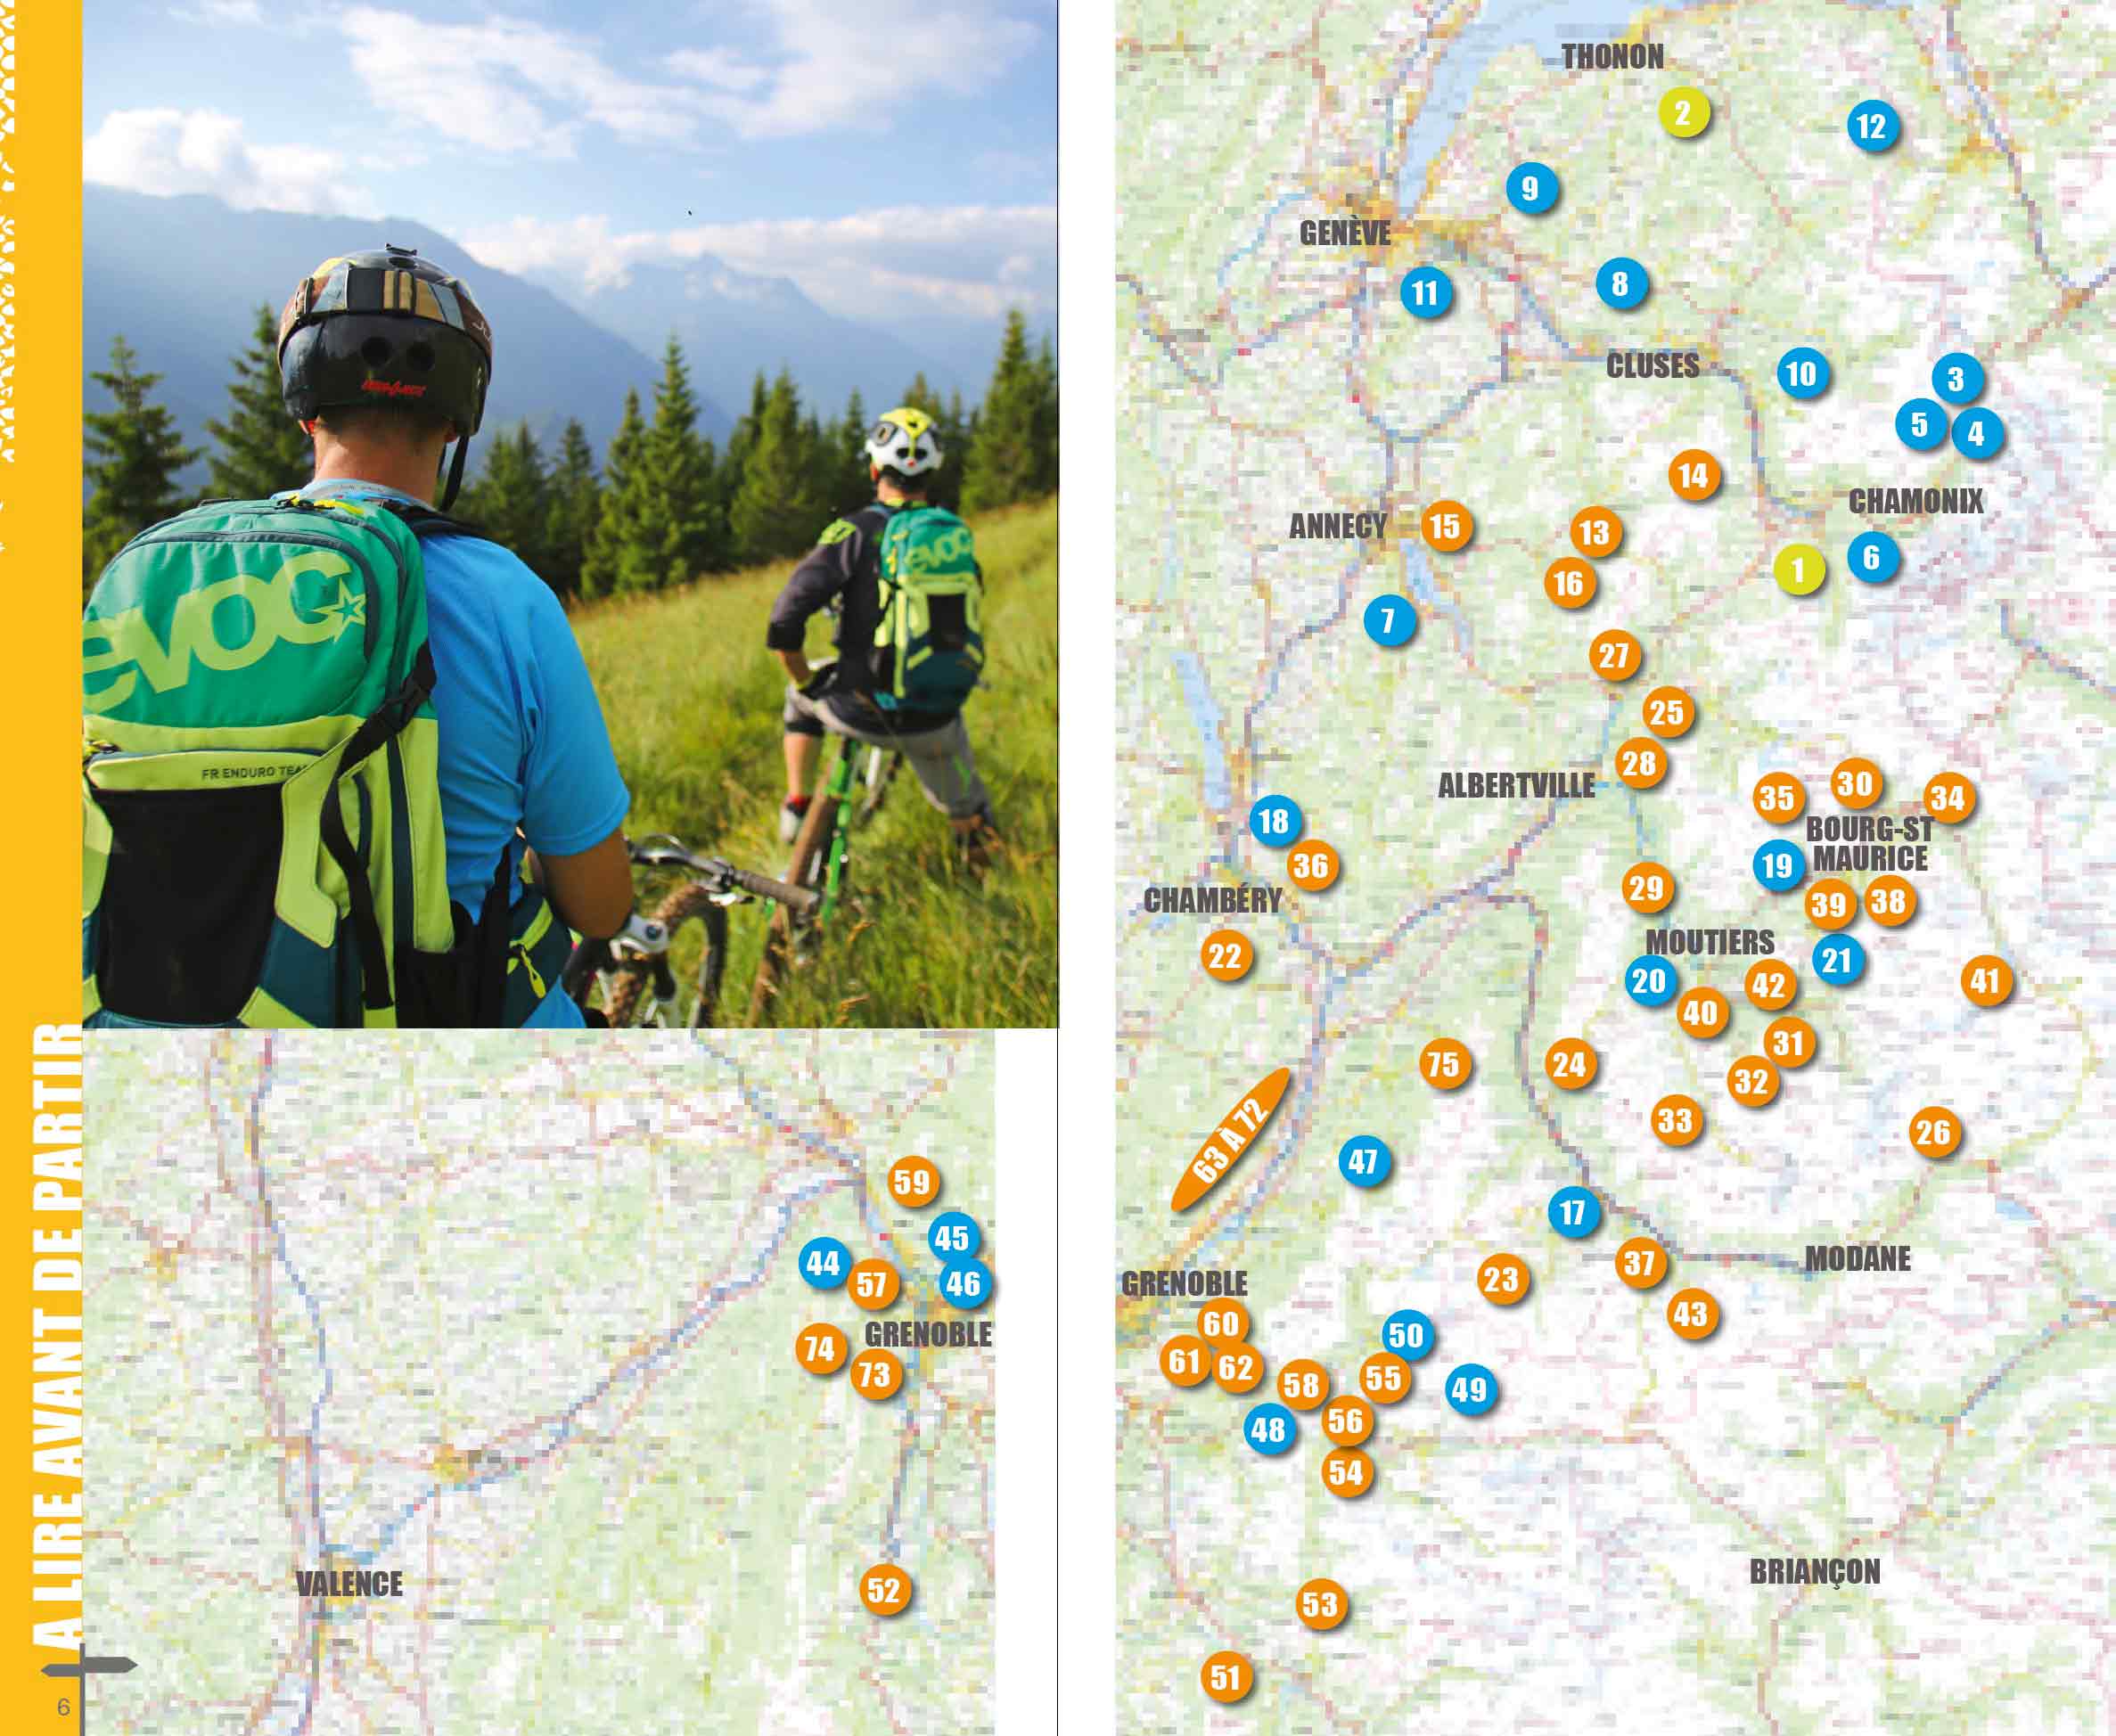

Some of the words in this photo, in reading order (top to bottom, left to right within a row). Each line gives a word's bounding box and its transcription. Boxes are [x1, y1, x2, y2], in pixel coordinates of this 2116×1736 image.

[1562, 44, 1663, 69] THONON
[1676, 101, 1690, 125] 2
[1858, 114, 1885, 138] 12
[1523, 176, 1538, 201] 9
[1300, 215, 1390, 245] GENÈVE
[1412, 281, 1436, 305] 11
[1612, 272, 1628, 296] 8
[1607, 353, 1700, 378] CLUSES
[1787, 362, 1816, 386] 10
[1948, 367, 1963, 391] 3
[1912, 413, 1927, 437] 5
[1968, 422, 1983, 446] 4
[1679, 463, 1708, 487] 14
[1849, 488, 1983, 513] CHAMONIX
[1290, 513, 1387, 538] ANNECY
[1431, 514, 1459, 538] 15
[1580, 520, 1609, 545] 13
[1864, 545, 1879, 569] 6
[1792, 558, 1802, 582] 1
[1554, 571, 1582, 595] 16
[1382, 609, 1393, 633] 7
[1600, 643, 1628, 667] 27
[1651, 700, 1683, 725] 25
[201, 768, 220, 780] FR
[223, 766, 275, 779] ENDURO
[277, 765, 308, 776] TEA
[1623, 751, 1655, 775] 28
[1439, 773, 1595, 798] ALBERTVILLE
[1839, 772, 1872, 796] 30
[1760, 786, 1793, 810] 35
[1931, 786, 1964, 810] 34
[1259, 809, 1288, 833] 18
[1807, 816, 1935, 841] BOURG-ST
[1294, 854, 1327, 878] 36
[1763, 854, 1792, 878] 19
[1813, 846, 1927, 871] MAURICE
[1144, 882, 1282, 913] CHAMBÉRY
[1630, 876, 1662, 900] 29
[1812, 893, 1845, 917] 39
[1872, 889, 1905, 913] 38
[1647, 929, 1774, 954] MOUTIERS
[1210, 944, 1241, 968] 22
[1823, 948, 1849, 972] 21
[1633, 969, 1665, 993] 20
[1753, 973, 1784, 997] 42
[1971, 969, 1997, 993] 41
[1684, 1001, 1717, 1025] 40
[1774, 1031, 1801, 1055] 31
[1429, 1052, 1458, 1077] 75
[1554, 1052, 1586, 1077] 24
[1735, 1069, 1767, 1093] 32
[33, 1024, 83, 1210] PARTIR
[1659, 1109, 1692, 1133] 33
[1193, 1146, 1229, 1183] 63
[1216, 1127, 1246, 1152] À
[1234, 1099, 1269, 1132] 72
[1917, 1120, 1949, 1144] 26
[1349, 1150, 1377, 1174] 47
[895, 1170, 929, 1194] 59
[1561, 1200, 1584, 1224] 17
[935, 1226, 968, 1250] 45
[33, 1229, 83, 1290] DE
[807, 1251, 839, 1275] 44
[1625, 1251, 1654, 1275] 37
[1807, 1246, 1910, 1271] MODANE
[857, 1273, 885, 1297] 57
[947, 1272, 980, 1296] 46
[1123, 1271, 1247, 1296] GRENOBLE
[1485, 1267, 1518, 1291] 23
[1204, 1312, 1238, 1336] 60
[1675, 1302, 1707, 1326] 43
[865, 1322, 991, 1347] GRENOBLE
[1390, 1323, 1423, 1347] 50
[806, 1337, 833, 1361] 74
[1169, 1349, 1198, 1373] 61
[859, 1363, 890, 1387] 73
[1219, 1355, 1252, 1380] 62
[1366, 1366, 1400, 1390] 55
[33, 1307, 83, 1478] AVANT
[1285, 1373, 1318, 1397] 58
[1453, 1378, 1486, 1402] 49
[1251, 1418, 1284, 1442] 48
[1329, 1409, 1362, 1433] 56
[1330, 1461, 1362, 1485] 54
[33, 1494, 83, 1601] LIRE
[296, 1571, 402, 1596] VALENCE
[1751, 1559, 1880, 1590] BRIANÇON
[868, 1578, 899, 1602] 52
[1304, 1593, 1337, 1617] 53
[33, 1617, 83, 1651] A
[1212, 1666, 1238, 1690] 51
[57, 1698, 70, 1716] 6
